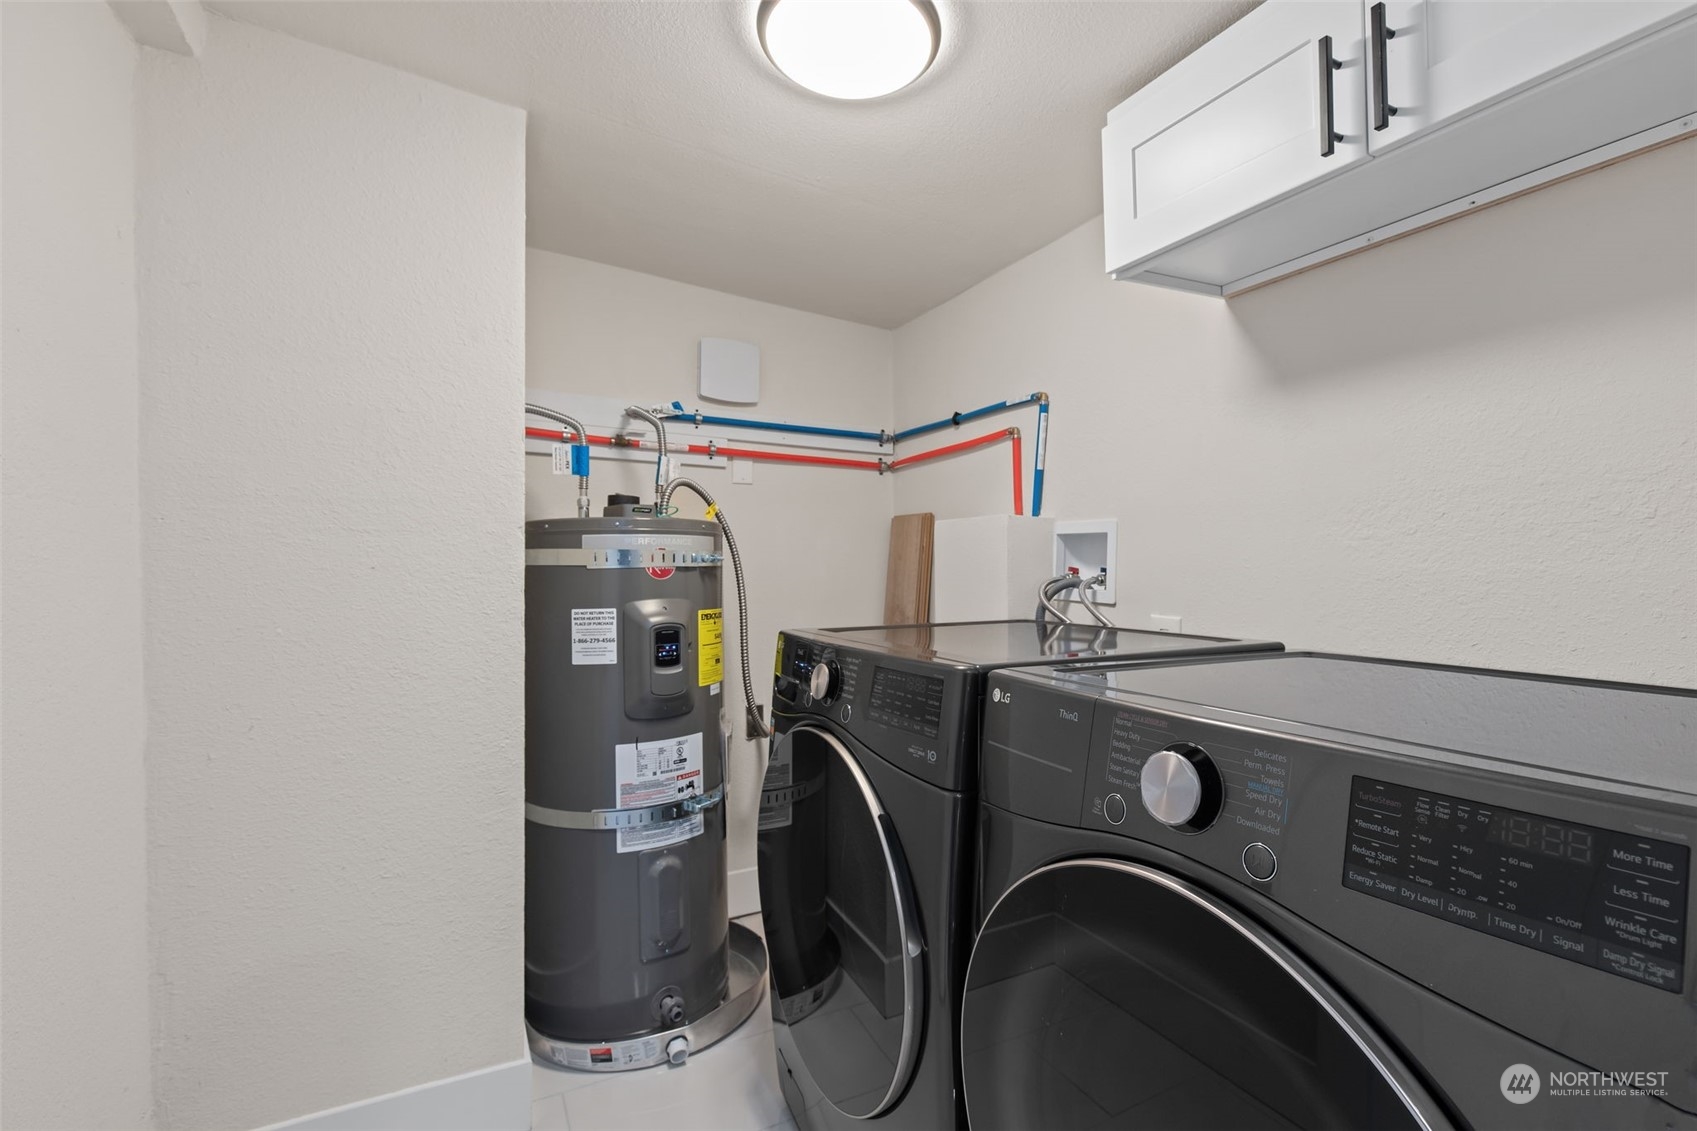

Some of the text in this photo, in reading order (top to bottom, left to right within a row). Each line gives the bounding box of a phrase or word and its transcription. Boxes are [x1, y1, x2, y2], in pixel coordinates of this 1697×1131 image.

[624, 537, 693, 546] PERFORMANCE
[1000, 691, 1011, 704] LG
[1059, 708, 1079, 722] ThinQ
[1254, 748, 1287, 763] Delicates
[1265, 763, 1286, 776] Press
[1260, 775, 1285, 788] Towels
[1246, 789, 1283, 807] Speed Dry
[1254, 806, 1281, 822] Air Dry
[1236, 815, 1280, 836] Downloaded
[1382, 825, 1400, 838] Start
[1418, 834, 1432, 844] Very
[1352, 843, 1399, 864] Reduce Static
[1416, 855, 1439, 866] Normal
[1612, 848, 1675, 871] More Time
[1508, 857, 1534, 870] 60 min
[1458, 866, 1482, 880] Normal
[1349, 871, 1397, 893] Energy Saver
[1415, 875, 1433, 887] Damp
[1507, 880, 1518, 889] 40
[1401, 887, 1439, 906] Dry Level
[1456, 887, 1467, 896] 20
[1612, 884, 1671, 908] Less Time
[1506, 903, 1517, 911] 20
[1493, 916, 1537, 939] Time Dry
[1555, 915, 1583, 930] On/Off
[1604, 915, 1678, 945] Wrinkle Care
[1552, 934, 1585, 952] Signal
[1602, 948, 1676, 979] Damp Dry Signal
